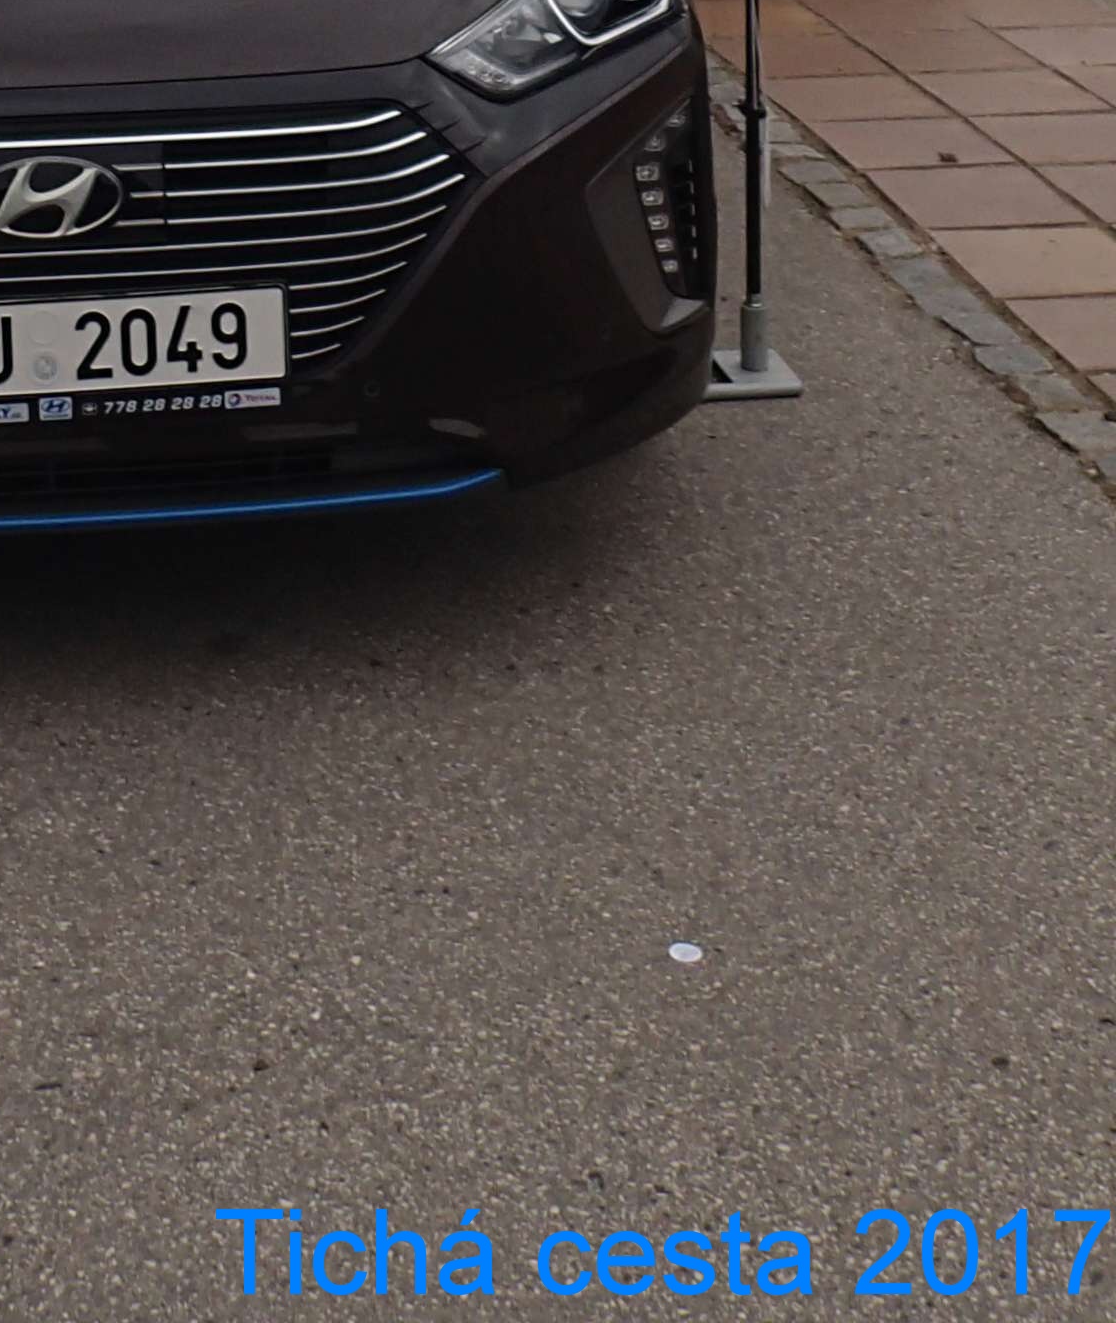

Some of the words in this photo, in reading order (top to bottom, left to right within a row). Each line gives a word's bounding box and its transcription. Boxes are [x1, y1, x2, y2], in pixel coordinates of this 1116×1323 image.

[73, 301, 249, 381] 2049
[103, 400, 138, 415] 778
[142, 398, 167, 412] 28
[171, 396, 195, 411] 28
[198, 394, 223, 409] 28
